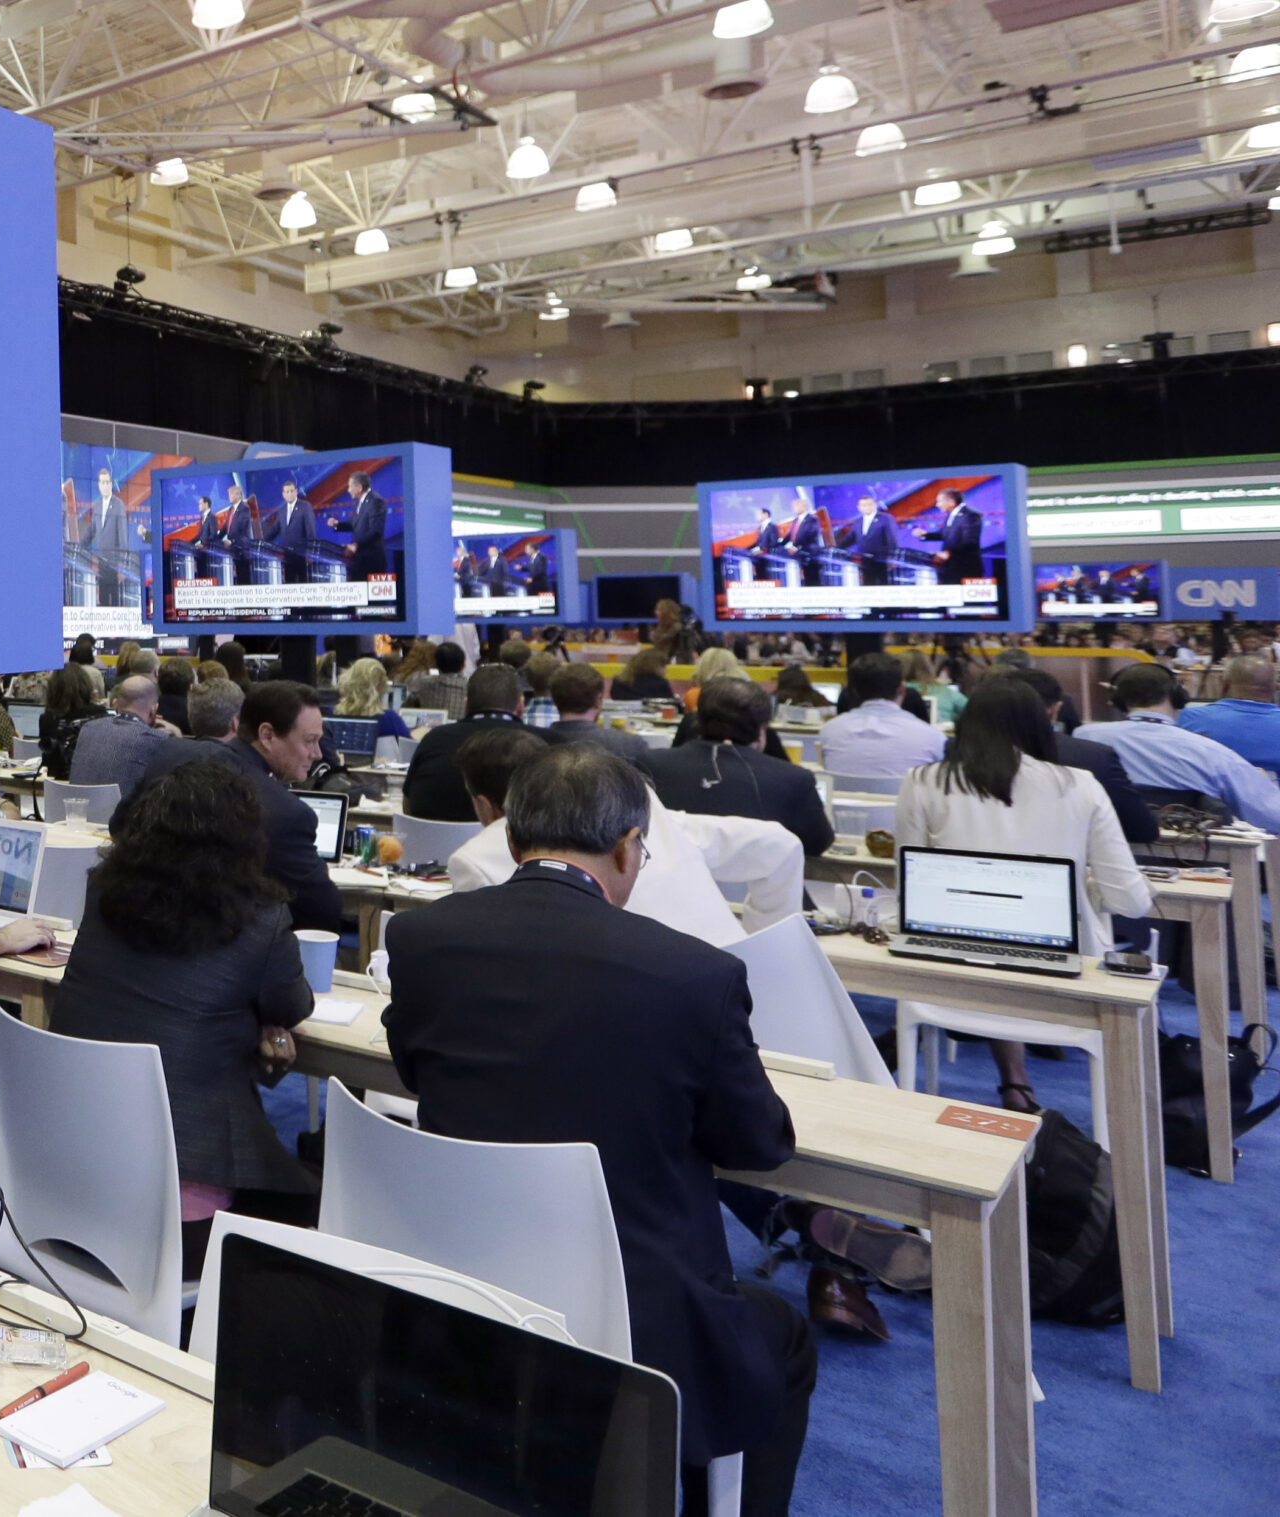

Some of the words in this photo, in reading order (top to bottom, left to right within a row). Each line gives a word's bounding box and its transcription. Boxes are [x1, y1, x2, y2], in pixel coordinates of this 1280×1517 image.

[177, 579, 213, 587] QUESTION
[200, 589, 215, 597] calls
[217, 588, 254, 597] opposition
[265, 587, 298, 595] Common
[300, 586, 317, 594] Core
[1176, 579, 1257, 607] CNN
[213, 597, 244, 606] response
[255, 595, 304, 604] conservatives
[325, 593, 362, 603] disagree?
[79, 610, 111, 621] Common
[70, 623, 117, 633] conservatives
[107, 1380, 138, 1398] Google
